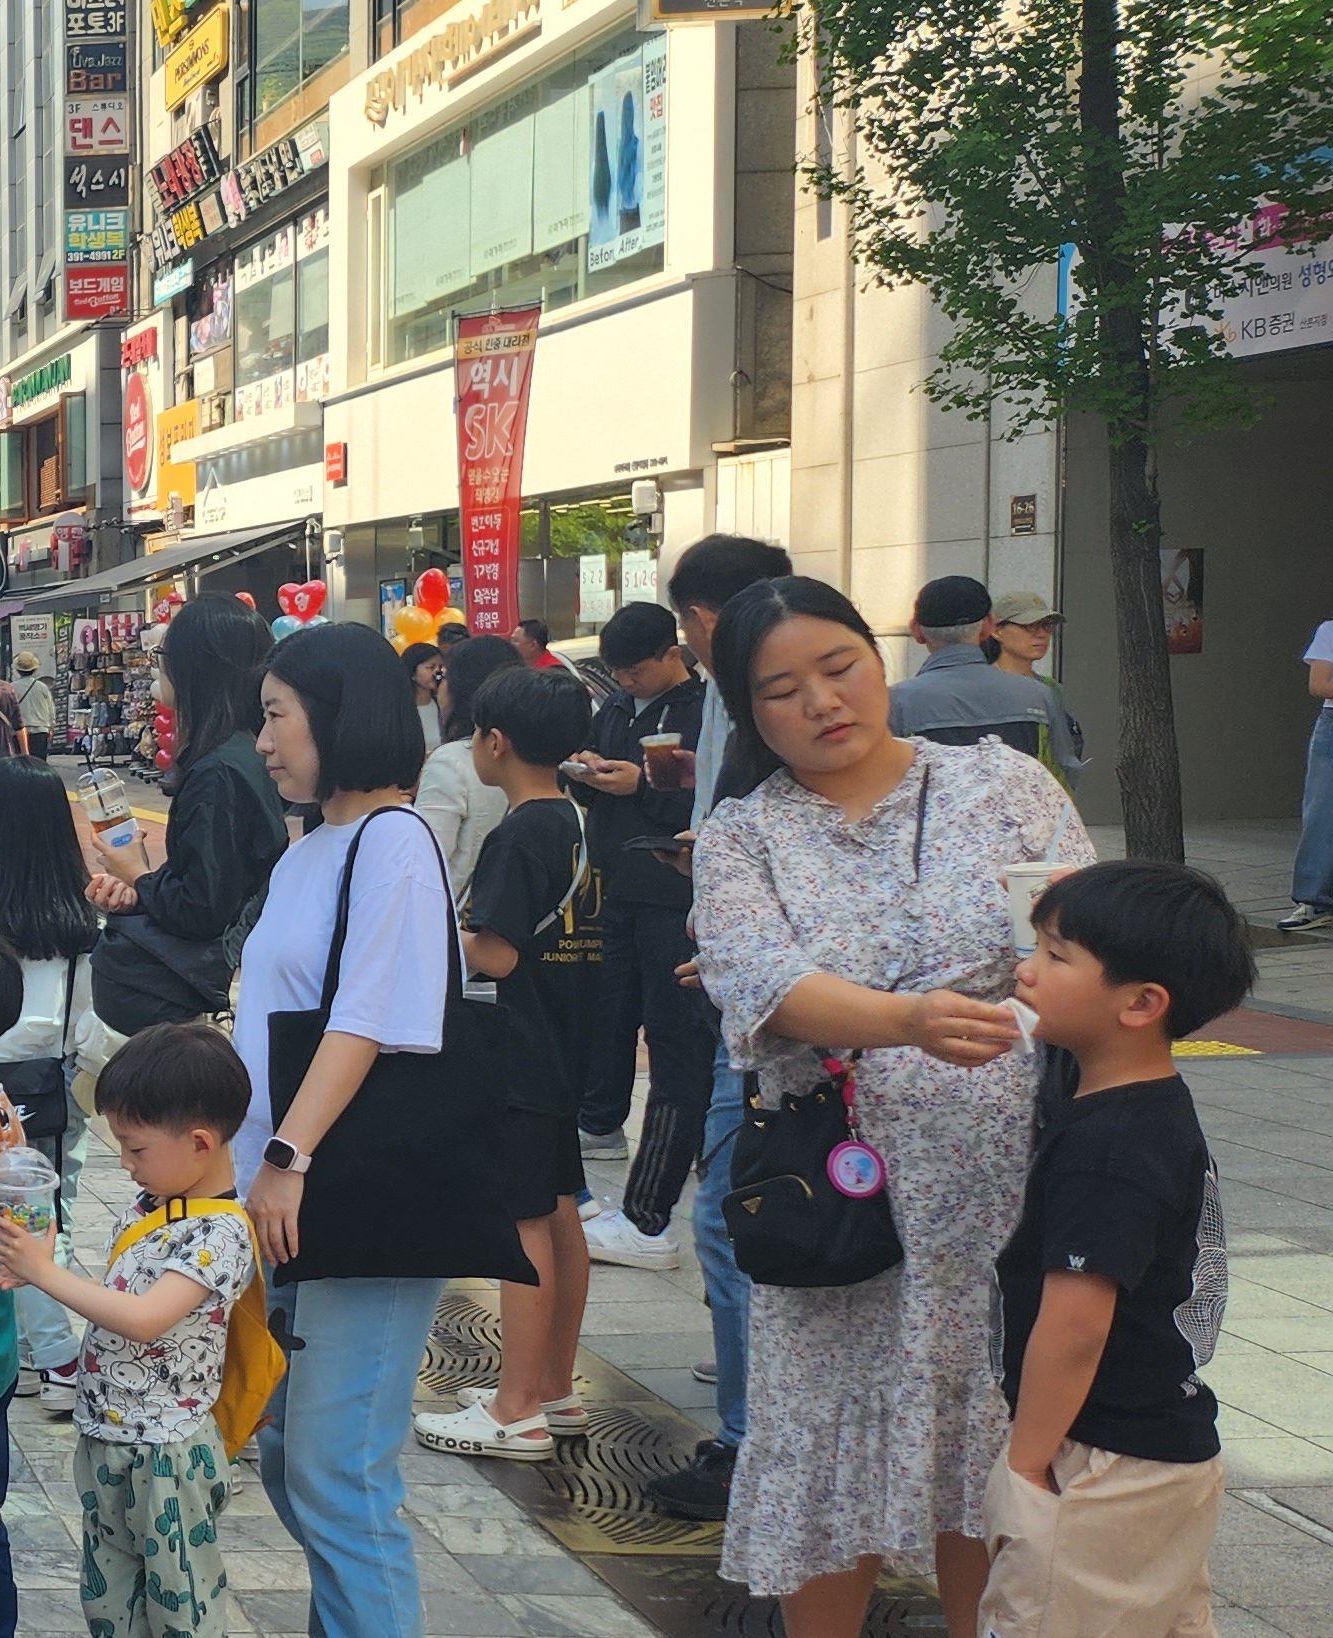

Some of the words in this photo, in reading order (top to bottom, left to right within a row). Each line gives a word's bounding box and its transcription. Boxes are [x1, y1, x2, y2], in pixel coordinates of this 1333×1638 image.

[97, 53, 122, 67] Jazz
[69, 69, 122, 92] Bar
[68, 103, 81, 114] 3F
[92, 101, 124, 112] 스튜디오
[69, 116, 124, 150] 댄스
[68, 212, 124, 232] 유니크
[68, 231, 124, 249] 학생복
[112, 250, 126, 261] 2F
[69, 277, 124, 294] 보드게임
[463, 337, 482, 353] 공식
[471, 356, 519, 399] 역시
[464, 400, 520, 461] SK
[425, 1431, 483, 1453] crocs
